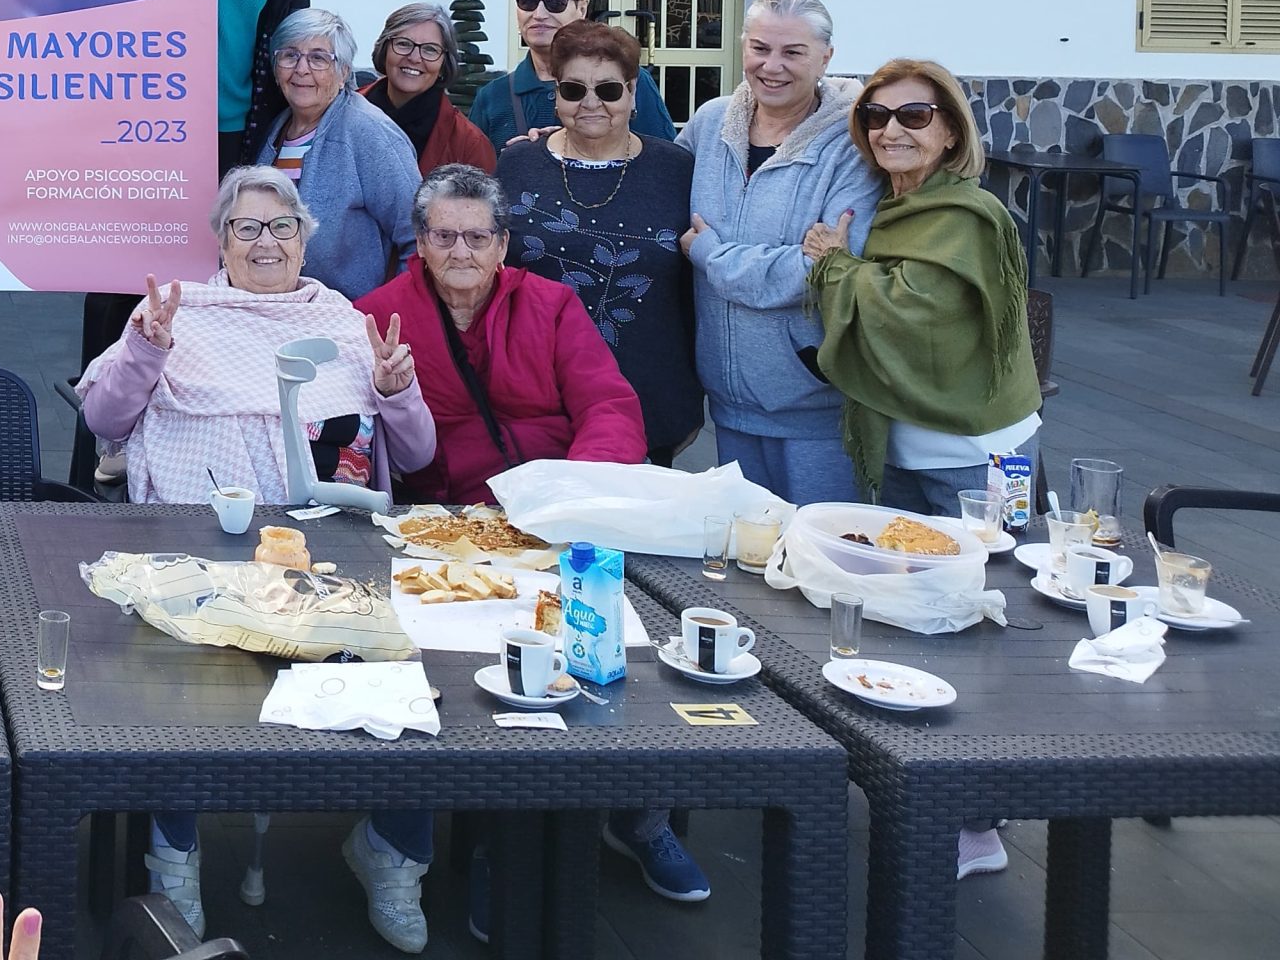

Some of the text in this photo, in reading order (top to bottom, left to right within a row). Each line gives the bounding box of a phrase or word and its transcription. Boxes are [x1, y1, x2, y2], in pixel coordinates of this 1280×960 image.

[7, 31, 187, 59] MAYORES
[24, 169, 189, 182] APOYO PSICOSOCIAL
[26, 185, 189, 200] FORMACIÓN DIGITAL
[8, 222, 189, 232] WWW.ONGBALANCEWORLD.ORG
[7, 234, 189, 245] INFO@ONGBALANCEWORLD.ORG
[564, 600, 596, 625] Agua
